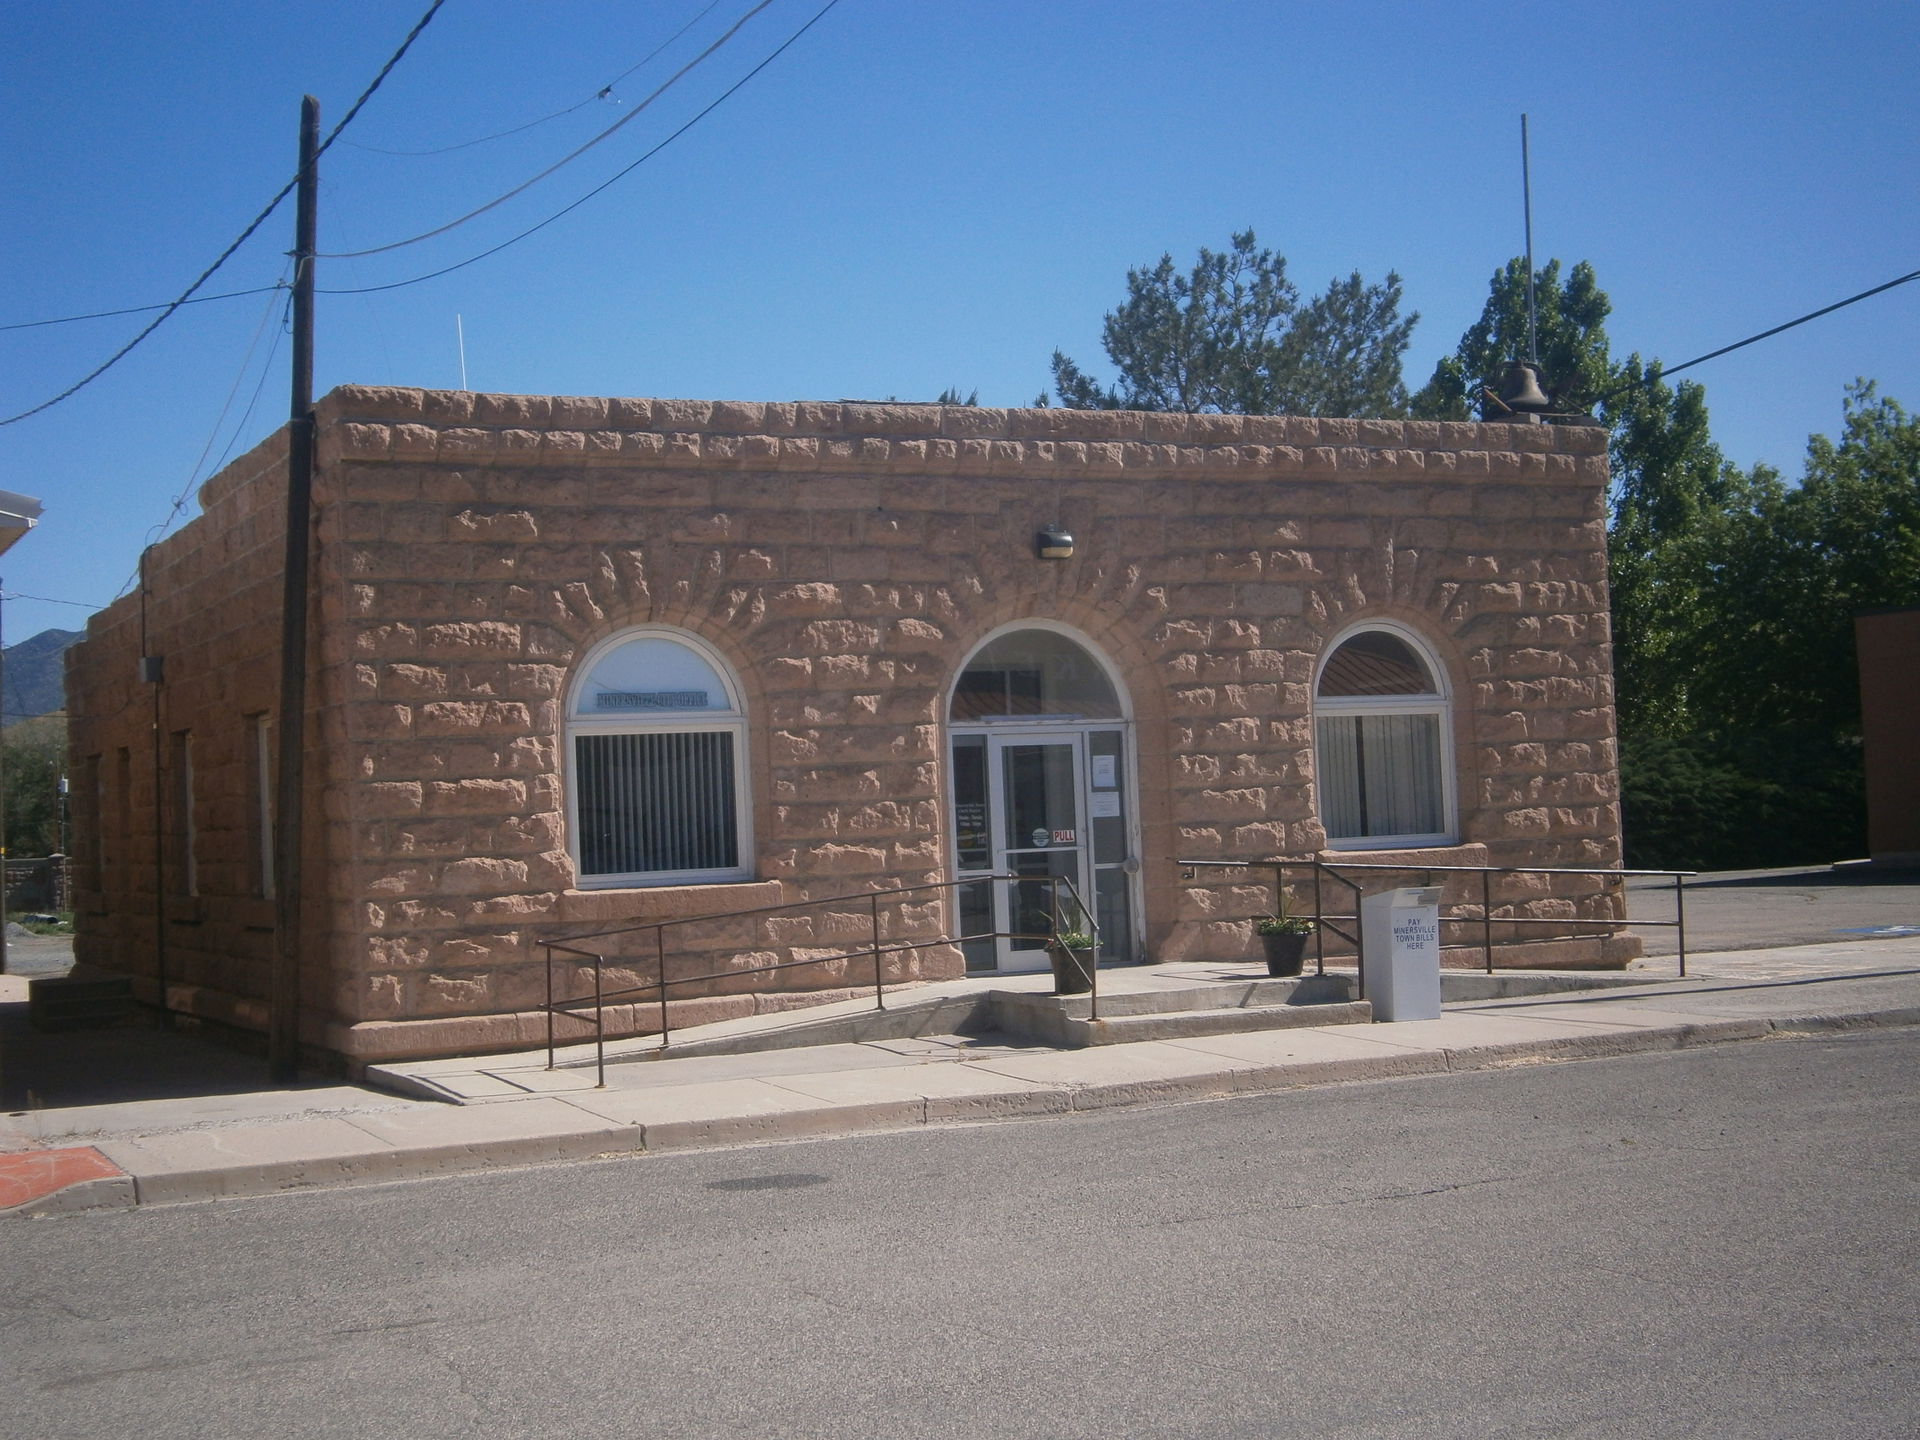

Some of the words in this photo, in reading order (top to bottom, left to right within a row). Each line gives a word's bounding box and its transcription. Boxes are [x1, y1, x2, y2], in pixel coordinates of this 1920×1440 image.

[1055, 831, 1073, 841] PULL
[1394, 926, 1436, 934] MINERSVILLE
[1407, 942, 1424, 950] HERE
